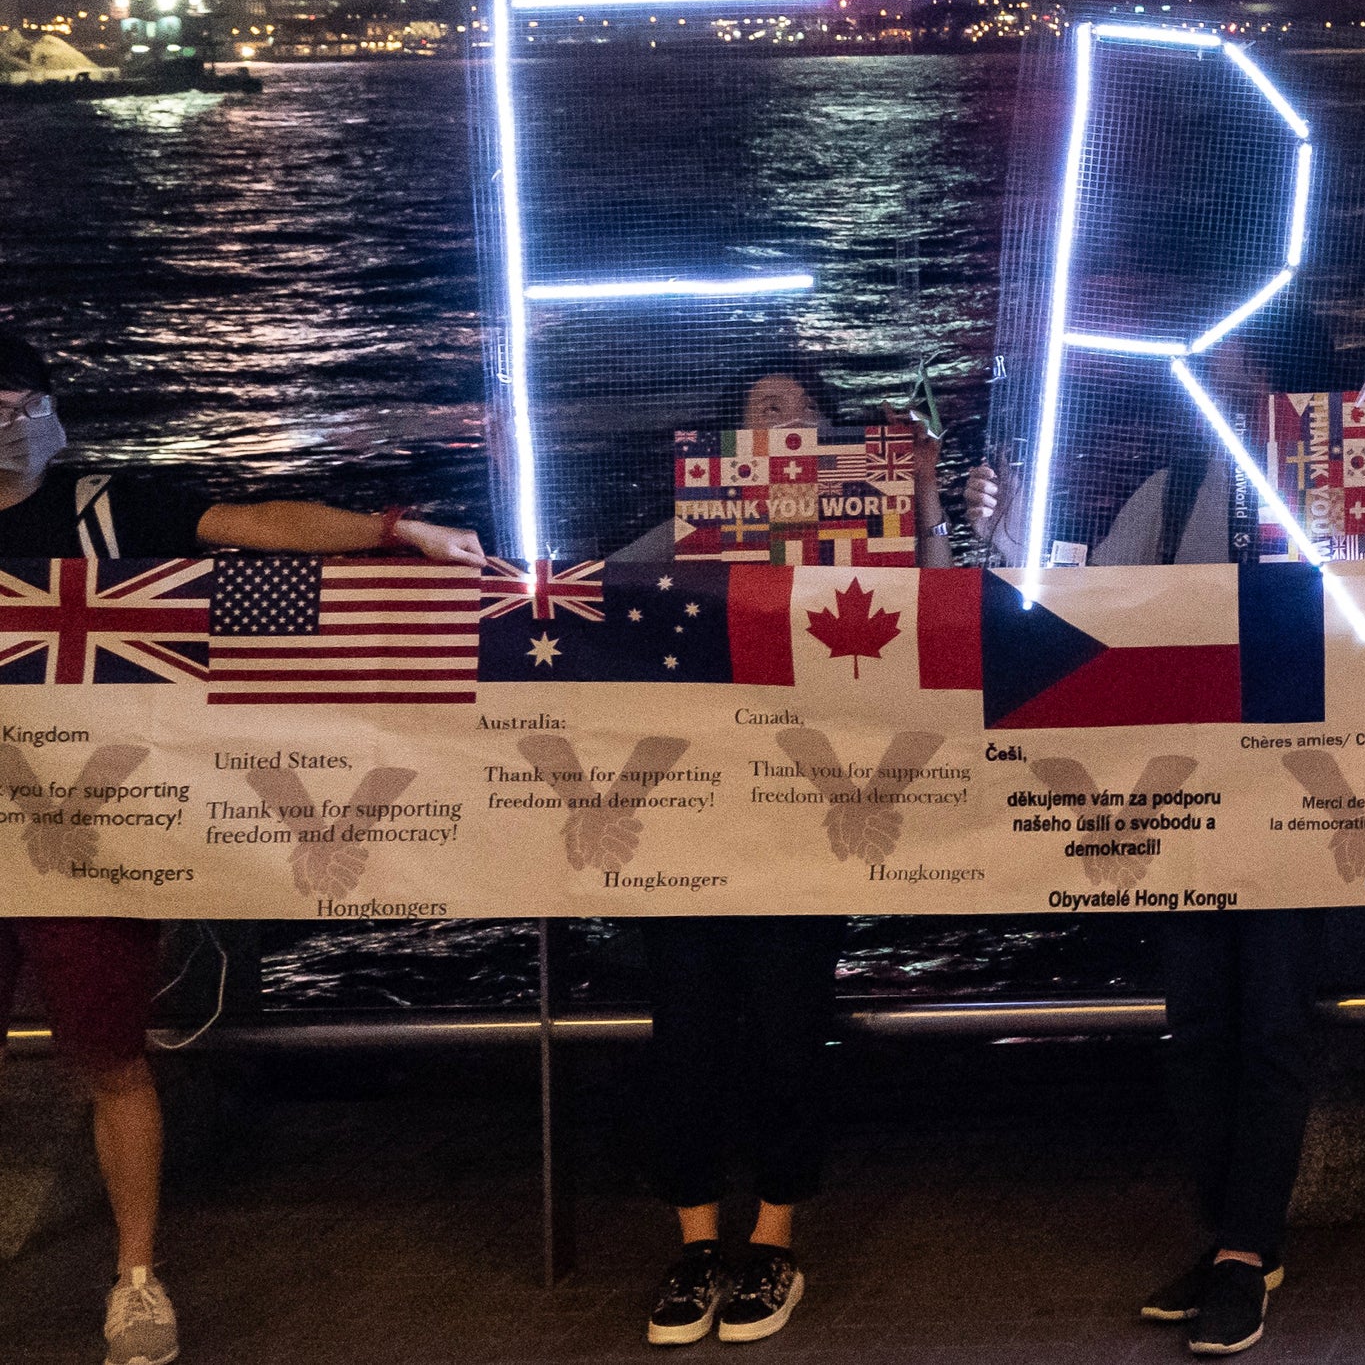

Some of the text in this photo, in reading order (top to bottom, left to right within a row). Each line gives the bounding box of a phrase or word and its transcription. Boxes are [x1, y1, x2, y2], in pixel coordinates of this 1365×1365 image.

[1309, 395, 1330, 480] THANK
[679, 495, 912, 521] THANK YOU WORLD
[1310, 484, 1330, 535] YOU
[476, 714, 567, 730] Australia:
[2, 726, 89, 747] Kingdom
[1241, 735, 1292, 749] Chères
[1297, 734, 1350, 747] amies/
[214, 752, 352, 770] United States,
[985, 743, 1027, 763] Češi,
[484, 766, 721, 786] Thank you for supporting
[11, 782, 190, 803] you for supporting
[488, 792, 714, 812] freedom and democracy!
[1007, 790, 1221, 809] děkujeme vám za podporu
[1302, 796, 1342, 809] Merci
[1347, 796, 1365, 808] de
[33, 809, 63, 824] and
[71, 809, 182, 831] democracy!
[207, 800, 462, 823] Thank you for supporting
[1013, 815, 1071, 832] našeho
[1115, 817, 1125, 831] o
[1130, 814, 1201, 830] svobodu
[1206, 817, 1215, 829] a
[1270, 818, 1283, 830] la
[206, 824, 458, 846] freedom and democracy!
[1064, 839, 1161, 857] demokracii!
[72, 861, 194, 885] Hongkongers
[602, 871, 728, 892] Hongkongers
[869, 865, 985, 884] Hongkongers
[317, 899, 447, 918] Hongkongers
[1049, 889, 1237, 911] Obyvatelé Hong Kongu
